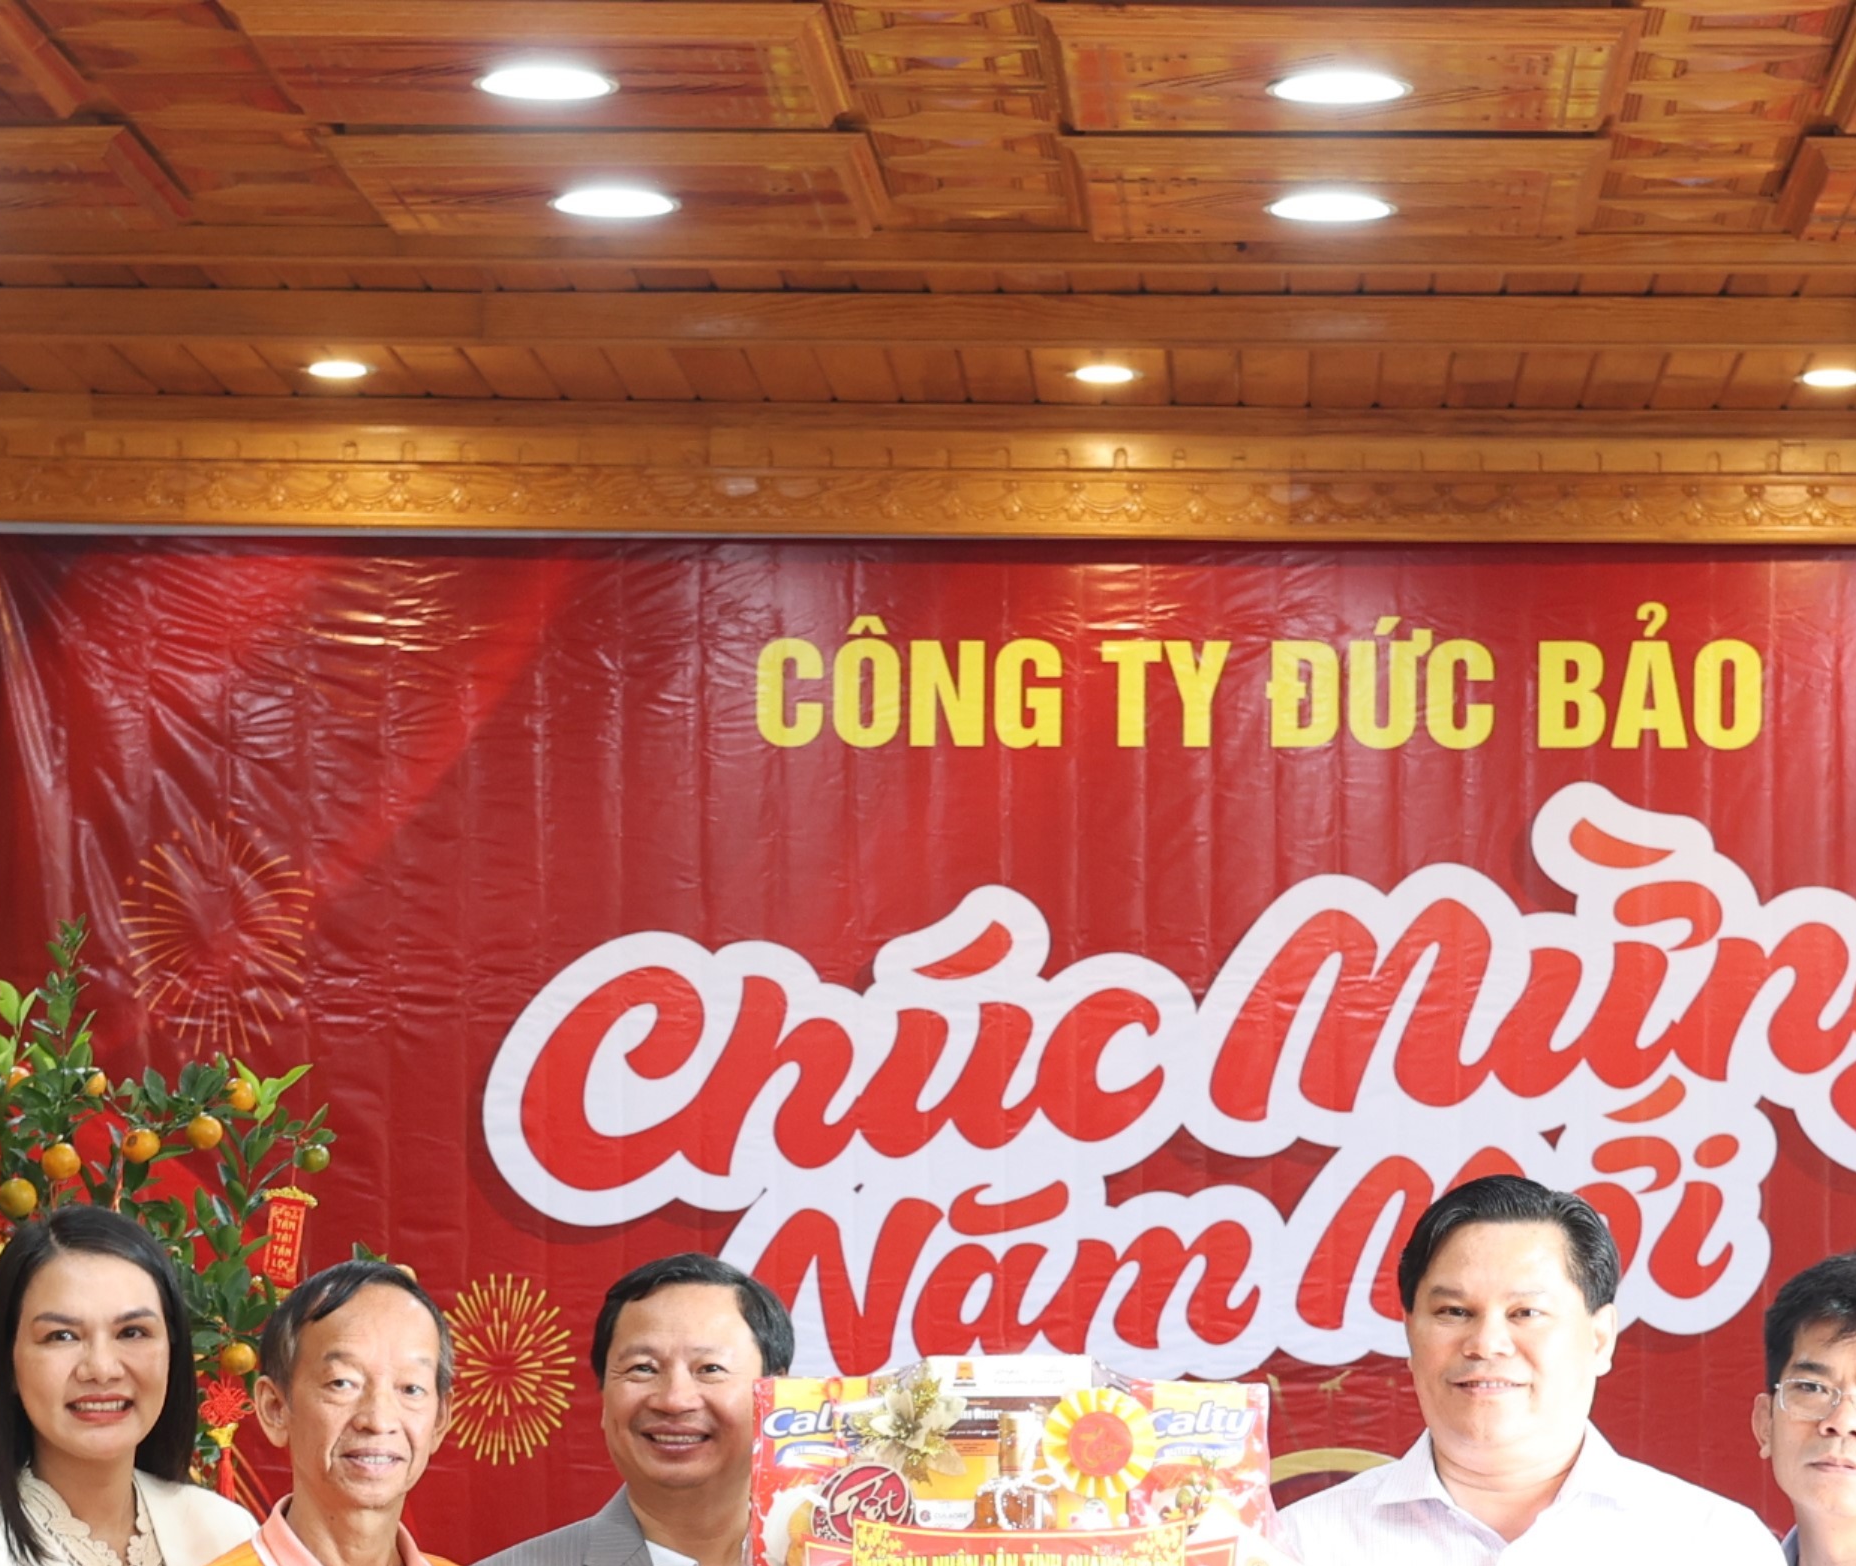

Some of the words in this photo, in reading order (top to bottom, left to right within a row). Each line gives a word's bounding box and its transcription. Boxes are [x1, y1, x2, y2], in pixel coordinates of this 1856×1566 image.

[756, 616, 1062, 749] CÔNG
[1102, 641, 1230, 748] TY
[1267, 616, 1496, 750] ĐỨC
[1537, 601, 1762, 750] BẢO
[518, 917, 1164, 1192] Chúc
[761, 1178, 1260, 1380] Năm
